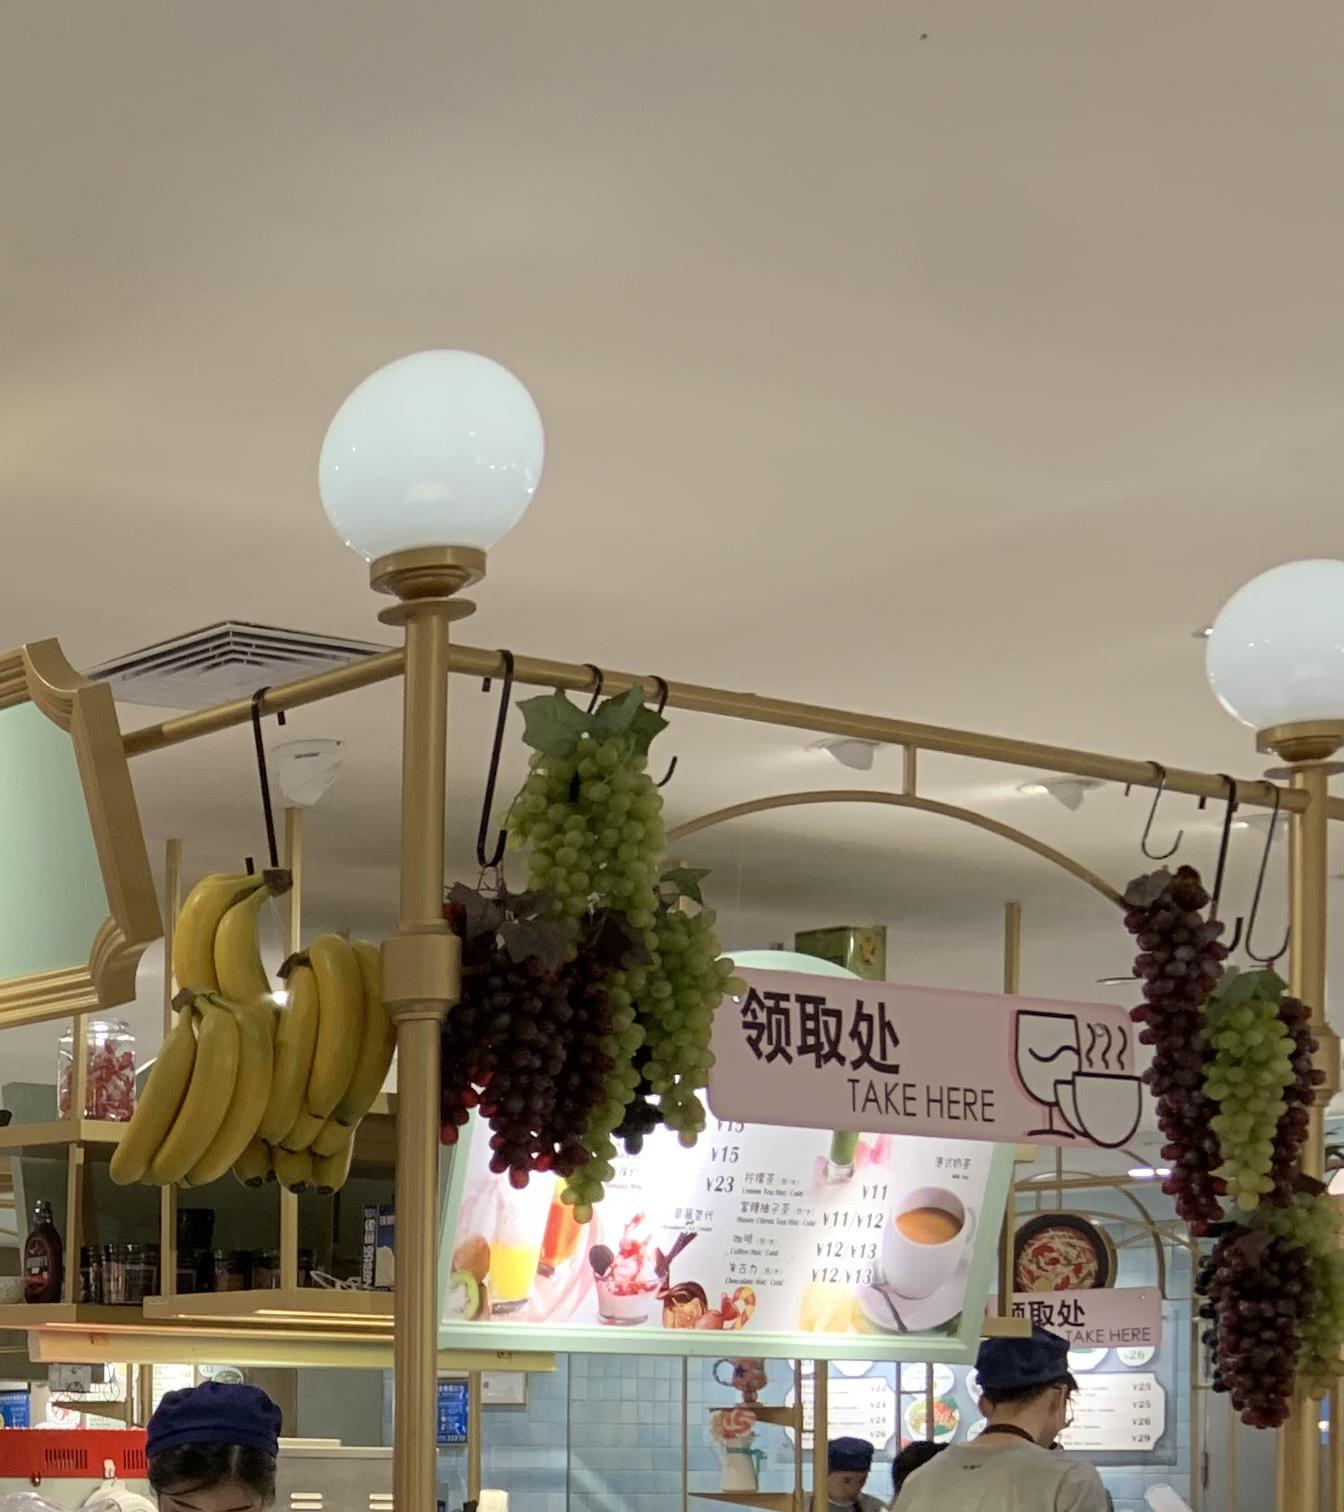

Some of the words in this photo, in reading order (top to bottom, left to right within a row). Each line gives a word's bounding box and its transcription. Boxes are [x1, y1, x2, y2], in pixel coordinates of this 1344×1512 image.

[740, 986, 901, 1075] 领取处
[846, 1078, 918, 1118] TAKE
[925, 1084, 996, 1123] HERE
[711, 1146, 740, 1163] ¥15
[706, 1176, 735, 1193] ¥23
[862, 1184, 889, 1200] ¥11
[1064, 1329, 1105, 1344] TAKE
[1109, 1326, 1152, 1342] HERE
